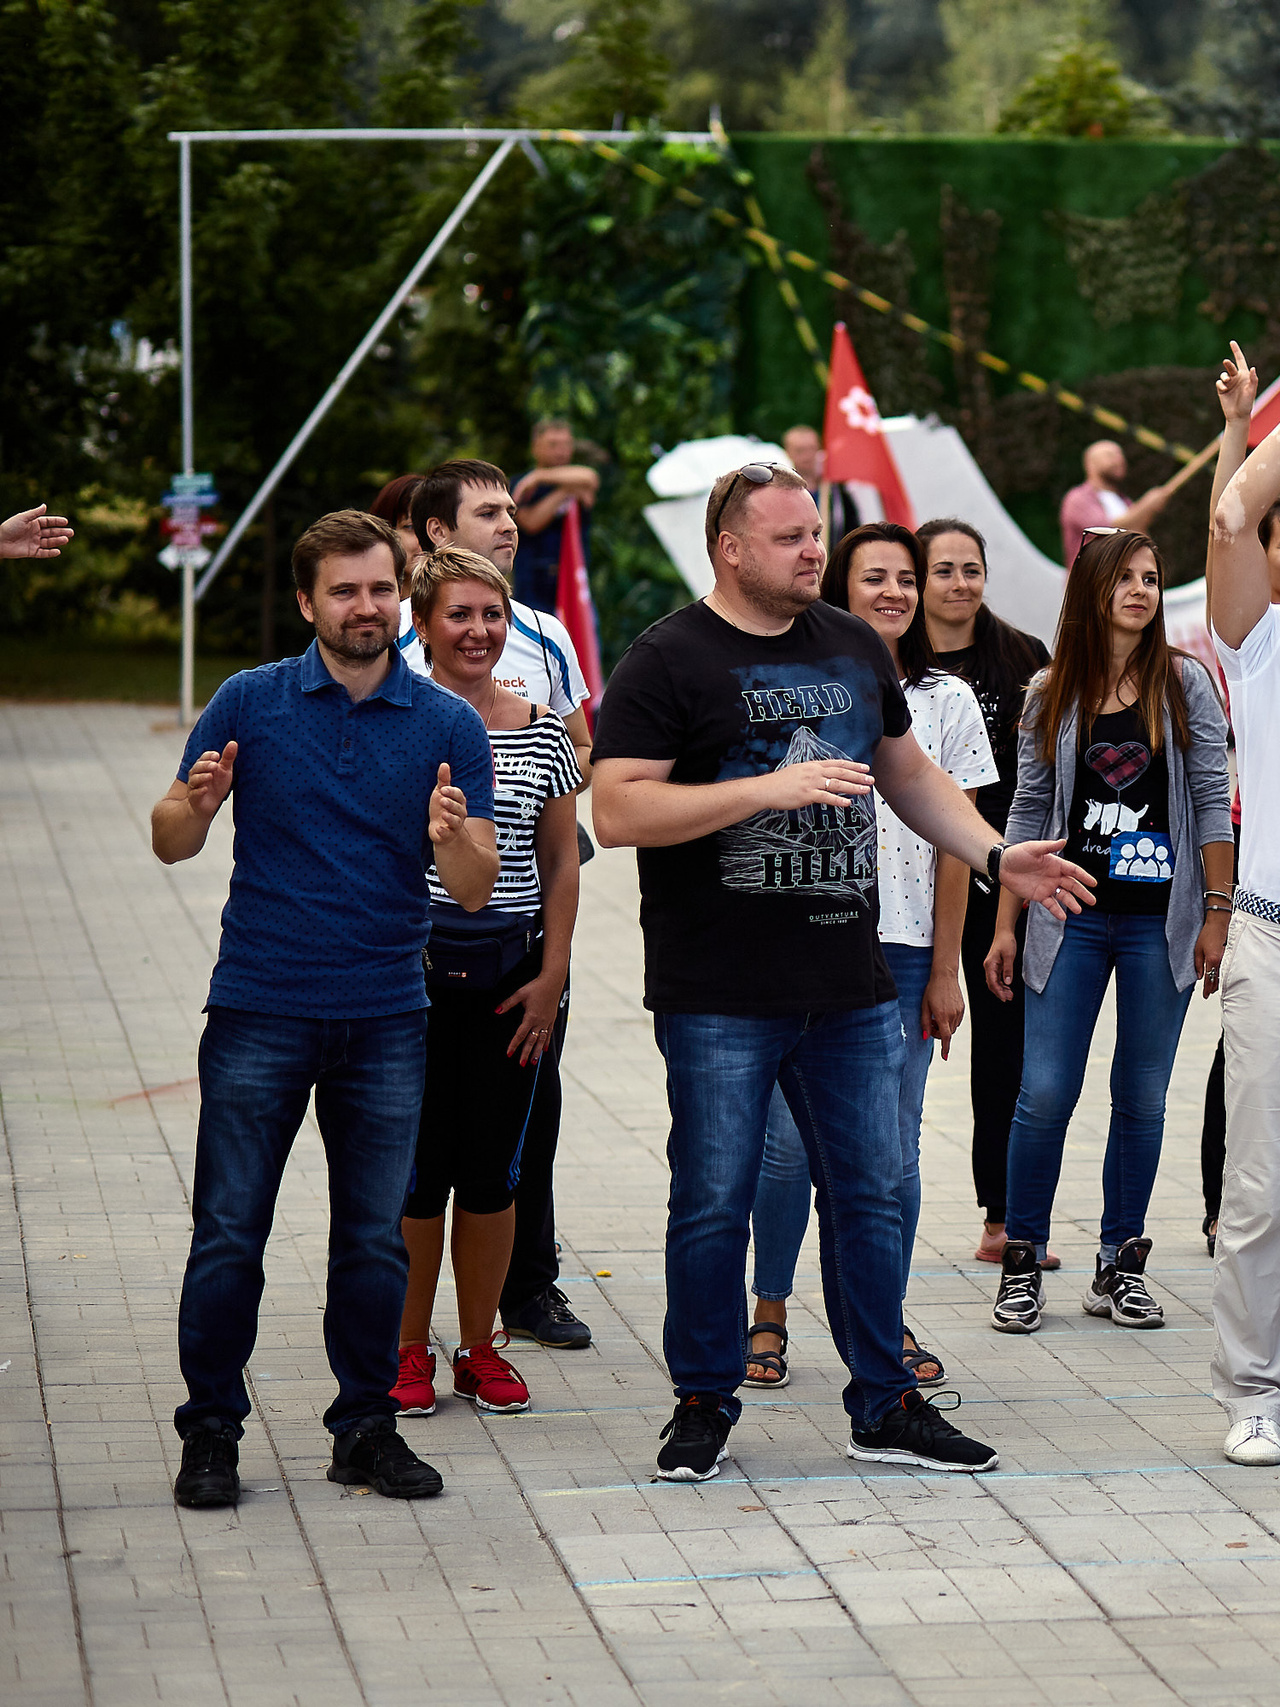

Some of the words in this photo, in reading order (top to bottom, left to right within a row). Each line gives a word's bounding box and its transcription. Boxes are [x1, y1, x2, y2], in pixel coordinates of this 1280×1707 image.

[741, 682, 852, 722] HEAD
[785, 794, 861, 836] THE
[760, 844, 875, 889] HILLS
[809, 911, 859, 921] OUTVENTURE
